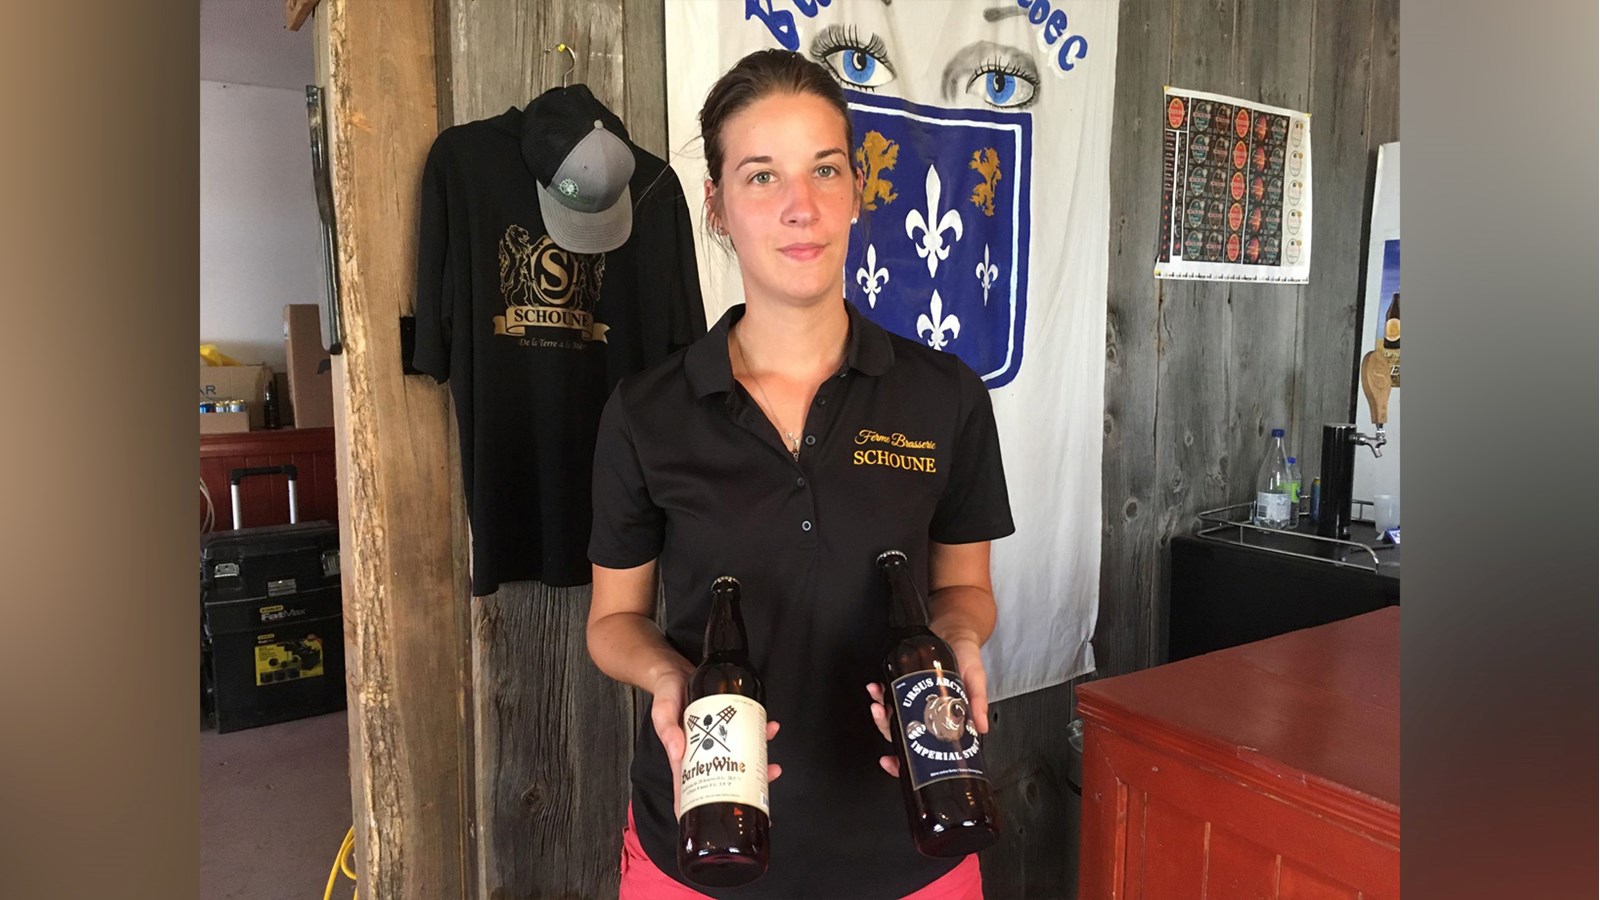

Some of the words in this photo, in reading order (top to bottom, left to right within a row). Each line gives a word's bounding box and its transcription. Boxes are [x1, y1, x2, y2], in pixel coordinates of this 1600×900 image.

[540, 248, 568, 291] S
[514, 308, 590, 327] SCHOUNE
[854, 429, 890, 445] Ferme
[891, 432, 936, 450] Brasserie
[853, 449, 937, 473] SCHOUNE
[902, 677, 934, 708] URSUS
[910, 740, 962, 761] IMPERIAL
[962, 737, 980, 759] STOUT
[682, 756, 746, 784] BarleyWine
